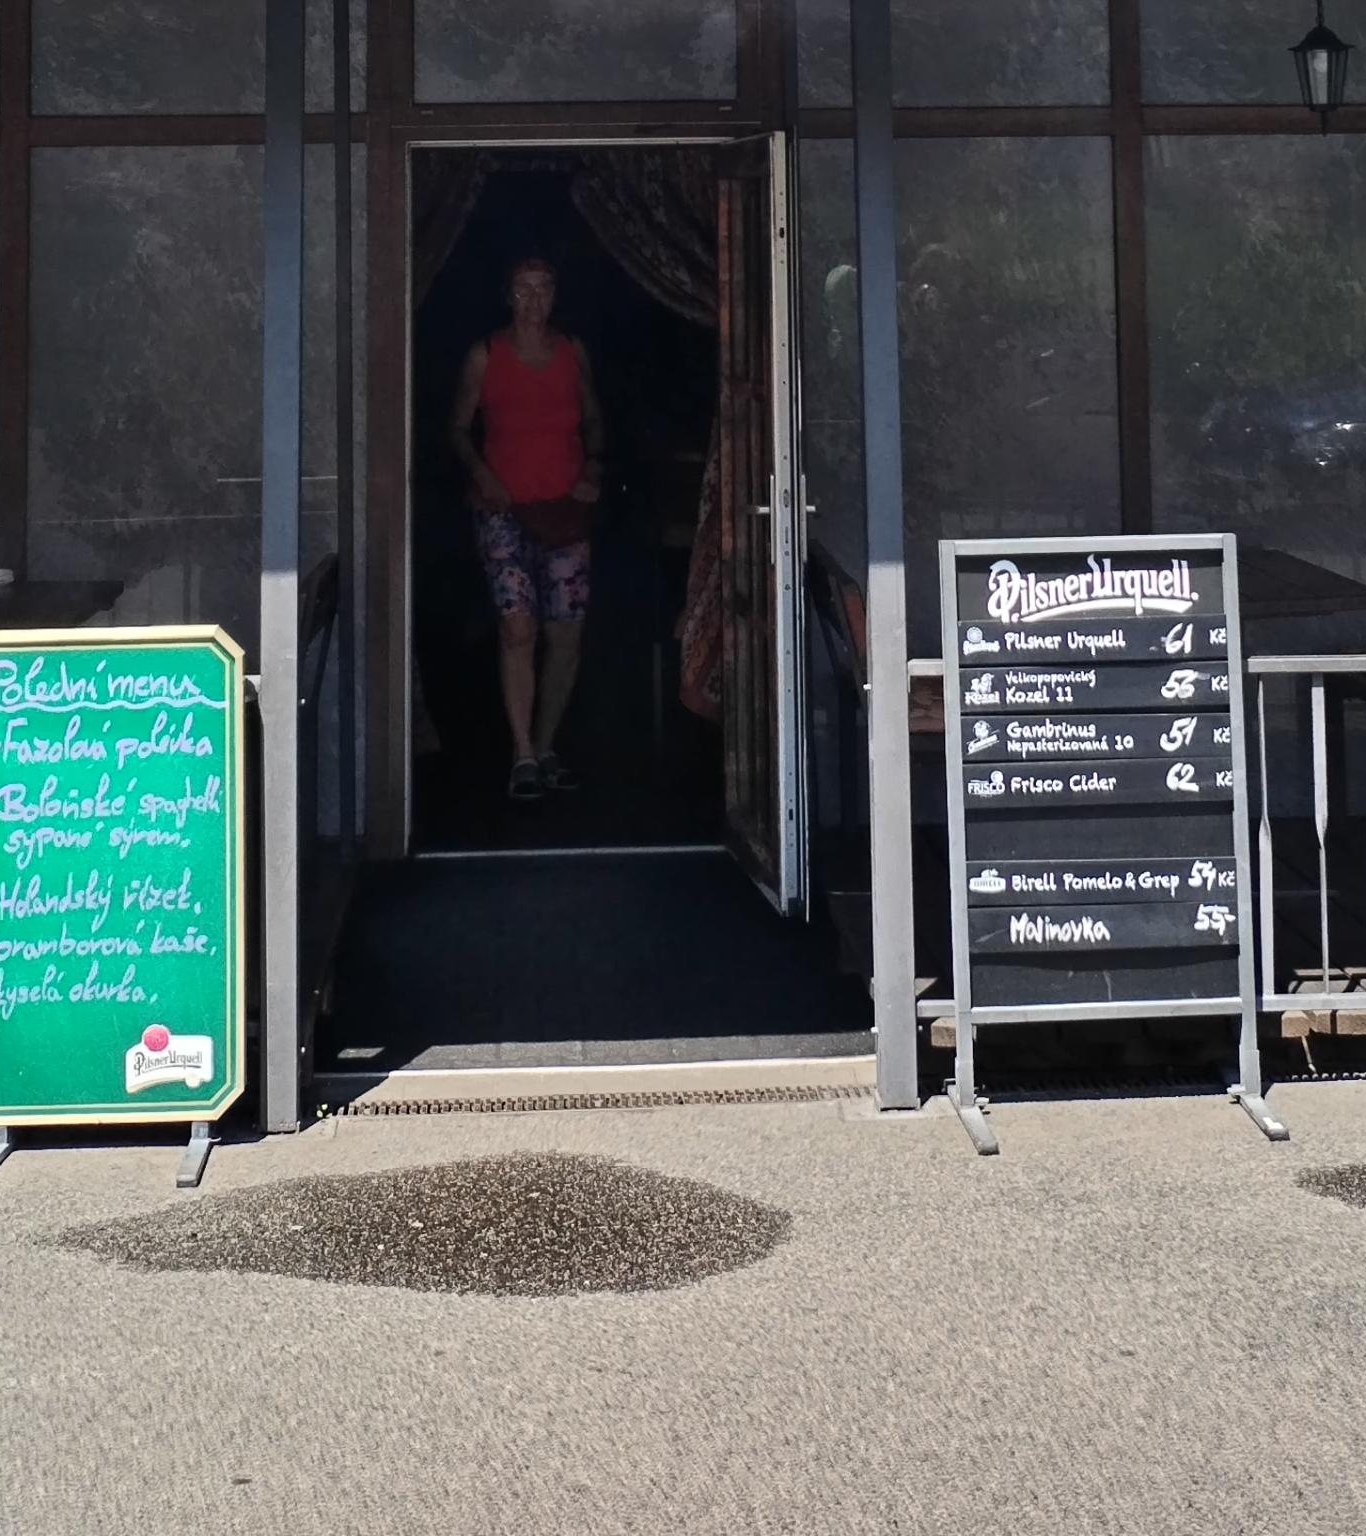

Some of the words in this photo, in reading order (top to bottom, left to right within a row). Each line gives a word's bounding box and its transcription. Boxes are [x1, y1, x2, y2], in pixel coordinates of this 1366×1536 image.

[988, 559, 1093, 624] Pilsner
[1087, 553, 1192, 616] Urquell
[1004, 631, 1062, 651] Pilsner
[1068, 628, 1126, 656] Urquell
[1165, 623, 1193, 654] 61
[1209, 627, 1227, 645] Kč
[107, 673, 201, 699] menu
[1005, 669, 1096, 688] Velkopopovický
[1006, 685, 1049, 704] Kozel
[1056, 685, 1073, 703] 11
[1211, 674, 1229, 692] Kč
[3, 715, 111, 764] Fazolová
[116, 711, 213, 770] polévka
[1007, 718, 1096, 739] Gambrinus
[1213, 726, 1231, 744] Kč
[1007, 735, 1109, 759] Nepasterizovaná
[1114, 734, 1134, 751] 10
[1011, 776, 1064, 794] Frisco
[1069, 771, 1117, 792] Cider
[1166, 762, 1199, 793] 62
[1216, 770, 1234, 787] Kč
[1012, 872, 1057, 892] Birell
[1063, 871, 1122, 892] Pomelo
[1125, 871, 1136, 891] &
[1138, 871, 1181, 898] Grep
[1218, 870, 1235, 888] Kč
[0, 868, 114, 934] Holandský
[1010, 912, 1111, 944] Malinovka
[133, 1051, 170, 1076] Pilsner
[168, 1050, 203, 1070] Urquell
